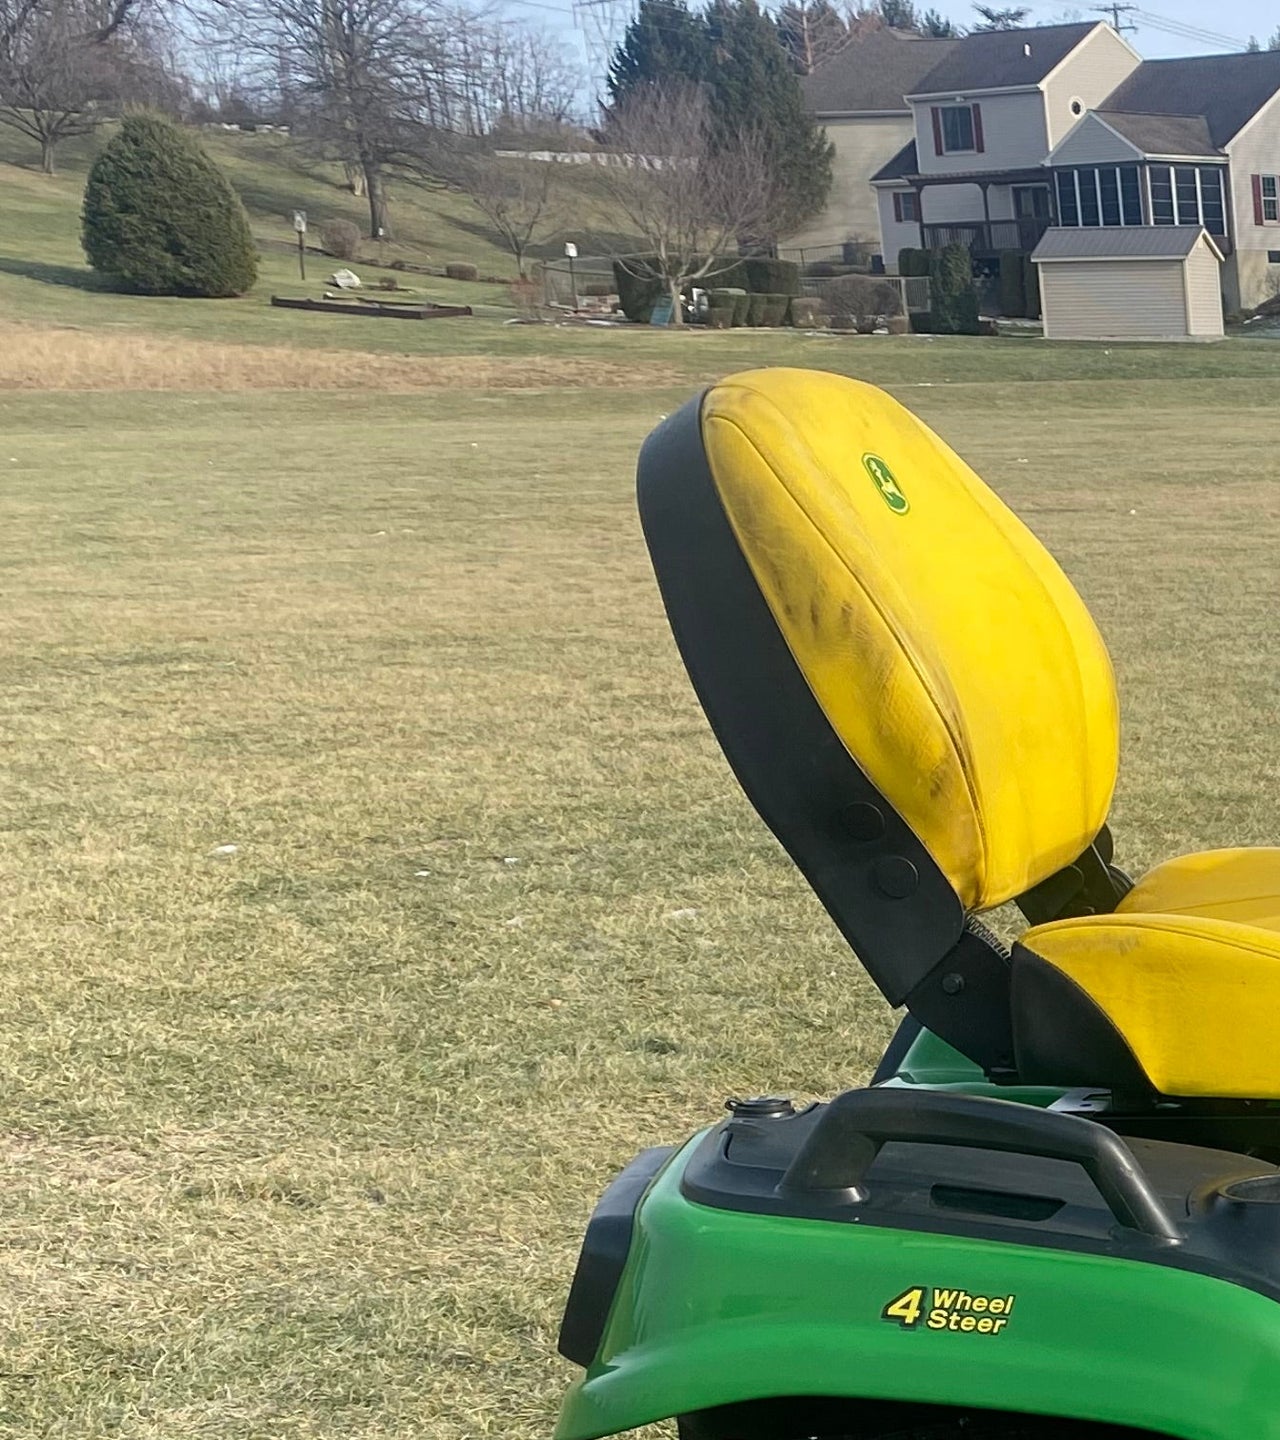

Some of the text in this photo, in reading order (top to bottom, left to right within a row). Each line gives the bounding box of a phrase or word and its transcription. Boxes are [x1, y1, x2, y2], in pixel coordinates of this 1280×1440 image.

[885, 1287, 1015, 1326] 4 Wheel
[926, 1308, 1007, 1334] Steer
